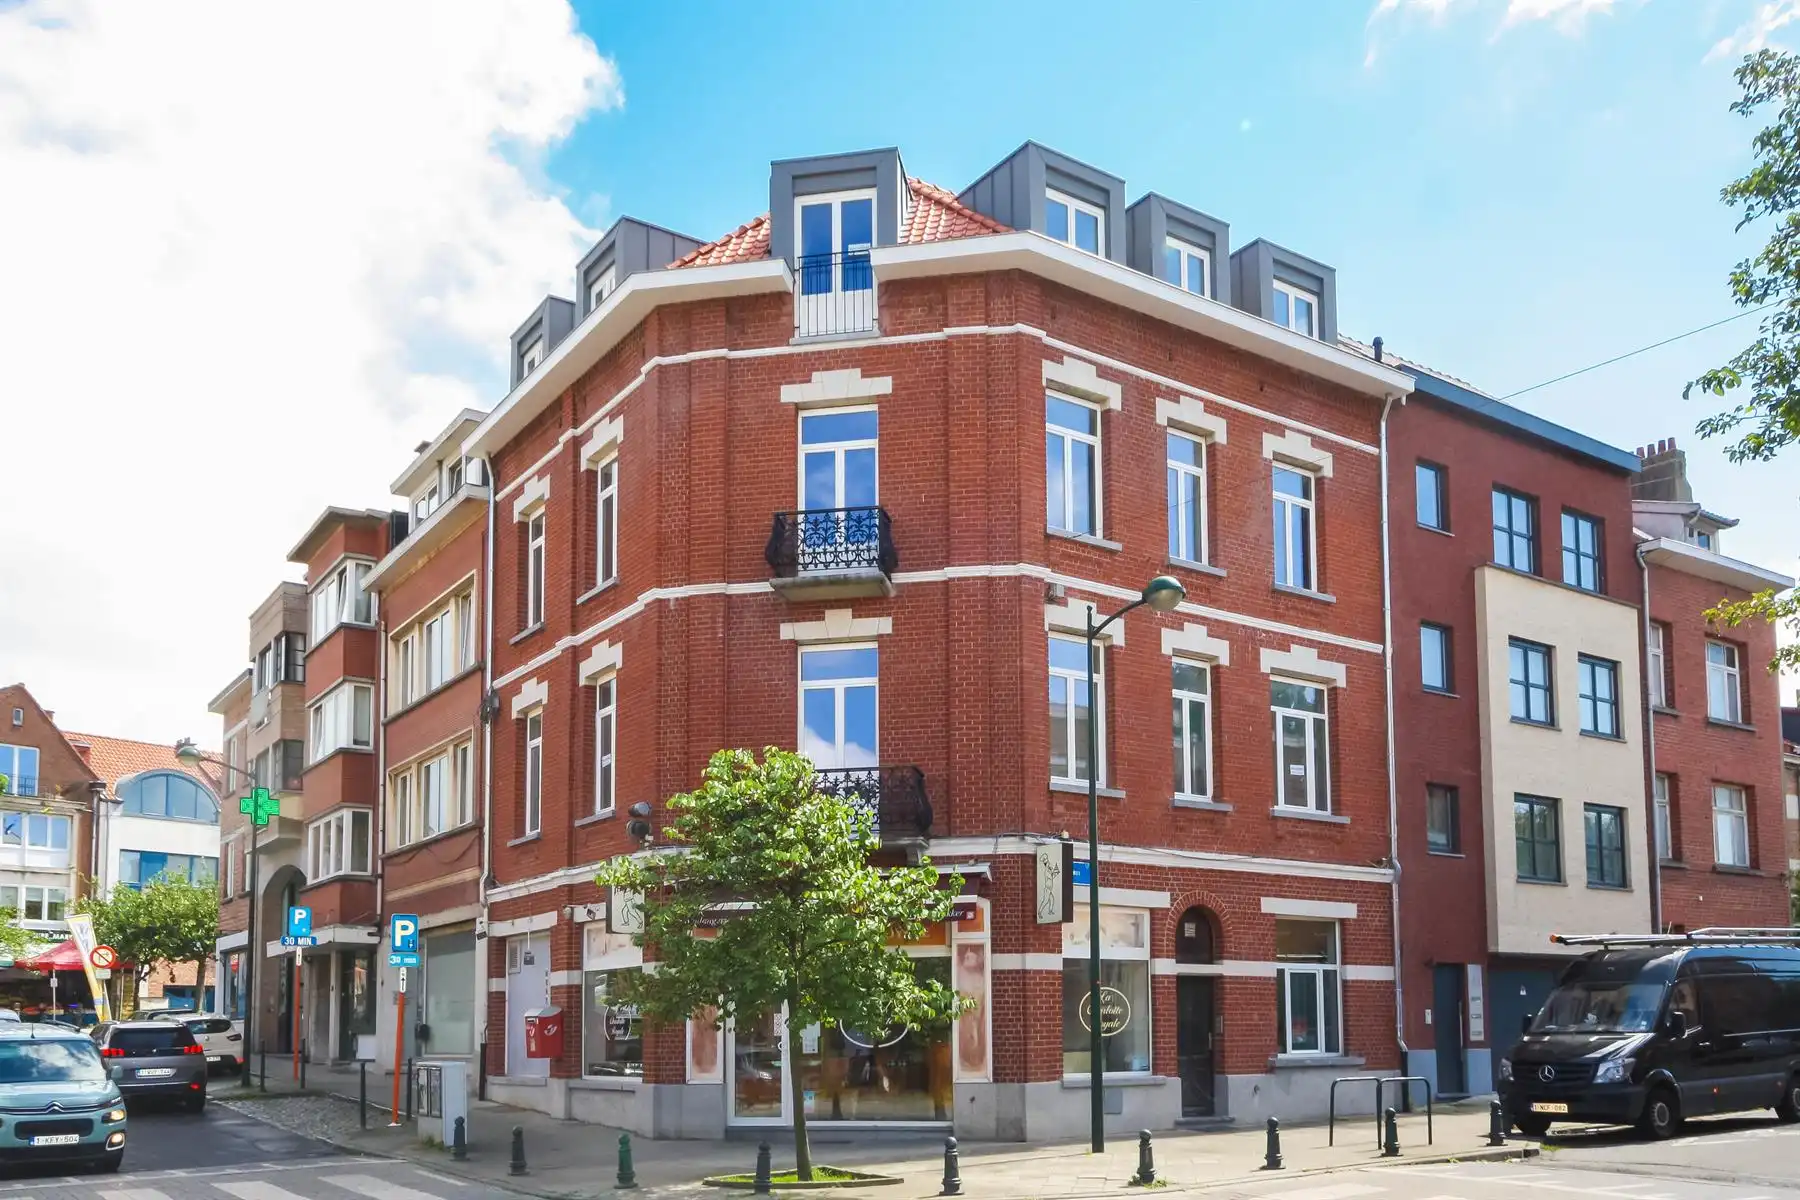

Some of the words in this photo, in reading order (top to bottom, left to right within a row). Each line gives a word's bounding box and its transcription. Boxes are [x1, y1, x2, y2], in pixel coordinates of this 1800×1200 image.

[294, 909, 307, 925] P
[284, 936, 295, 946] 30
[394, 919, 415, 947] P
